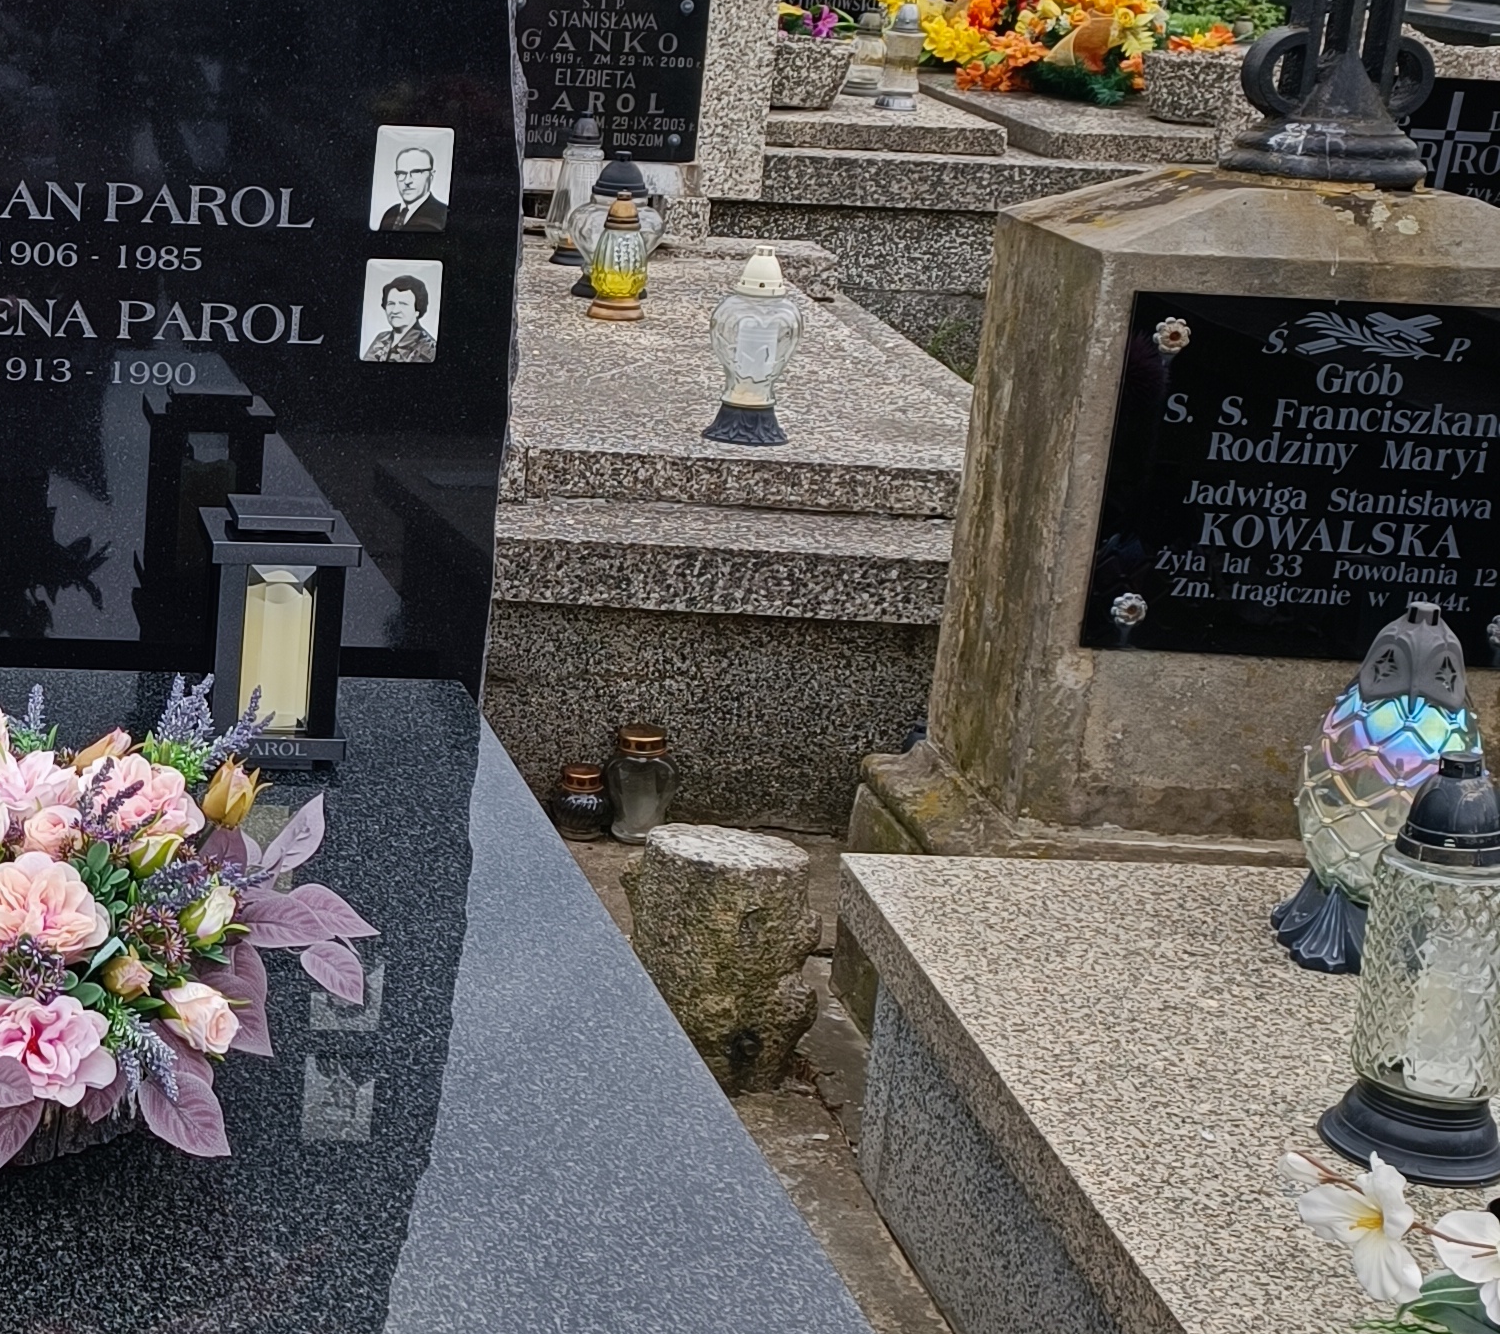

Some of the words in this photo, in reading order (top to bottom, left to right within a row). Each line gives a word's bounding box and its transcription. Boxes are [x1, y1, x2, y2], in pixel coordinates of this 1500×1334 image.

[548, 9, 658, 30] STANISŁAWA
[527, 126, 557, 146] OKÓJ
[613, 132, 663, 148] DUSZOM
[595, 115, 608, 129] M.
[104, 182, 315, 228] PAROL
[118, 245, 202, 271] 1985
[116, 300, 325, 345] PAROL
[1261, 321, 1288, 355] Ś.
[1443, 337, 1471, 362] P.
[111, 361, 196, 386] 1990
[1316, 363, 1404, 397] Grób
[1164, 393, 1194, 423] S.
[1218, 396, 1248, 426] S.
[1272, 398, 1500, 438] Franciszkan
[1207, 431, 1358, 475] Rodziny
[1380, 440, 1489, 480] Maryi
[1183, 480, 1308, 516] Jadwiga
[1328, 487, 1492, 520] Stanisława
[1198, 512, 1462, 559] KOWALSKA
[1155, 545, 1206, 576] Żyła
[1222, 552, 1251, 574] lat
[1266, 554, 1303, 578] 33
[1473, 568, 1498, 587] 12
[1170, 577, 1215, 599] Zm.
[1231, 581, 1351, 608] tragicznie
[1369, 591, 1390, 608] w
[250, 742, 308, 757] AROL
